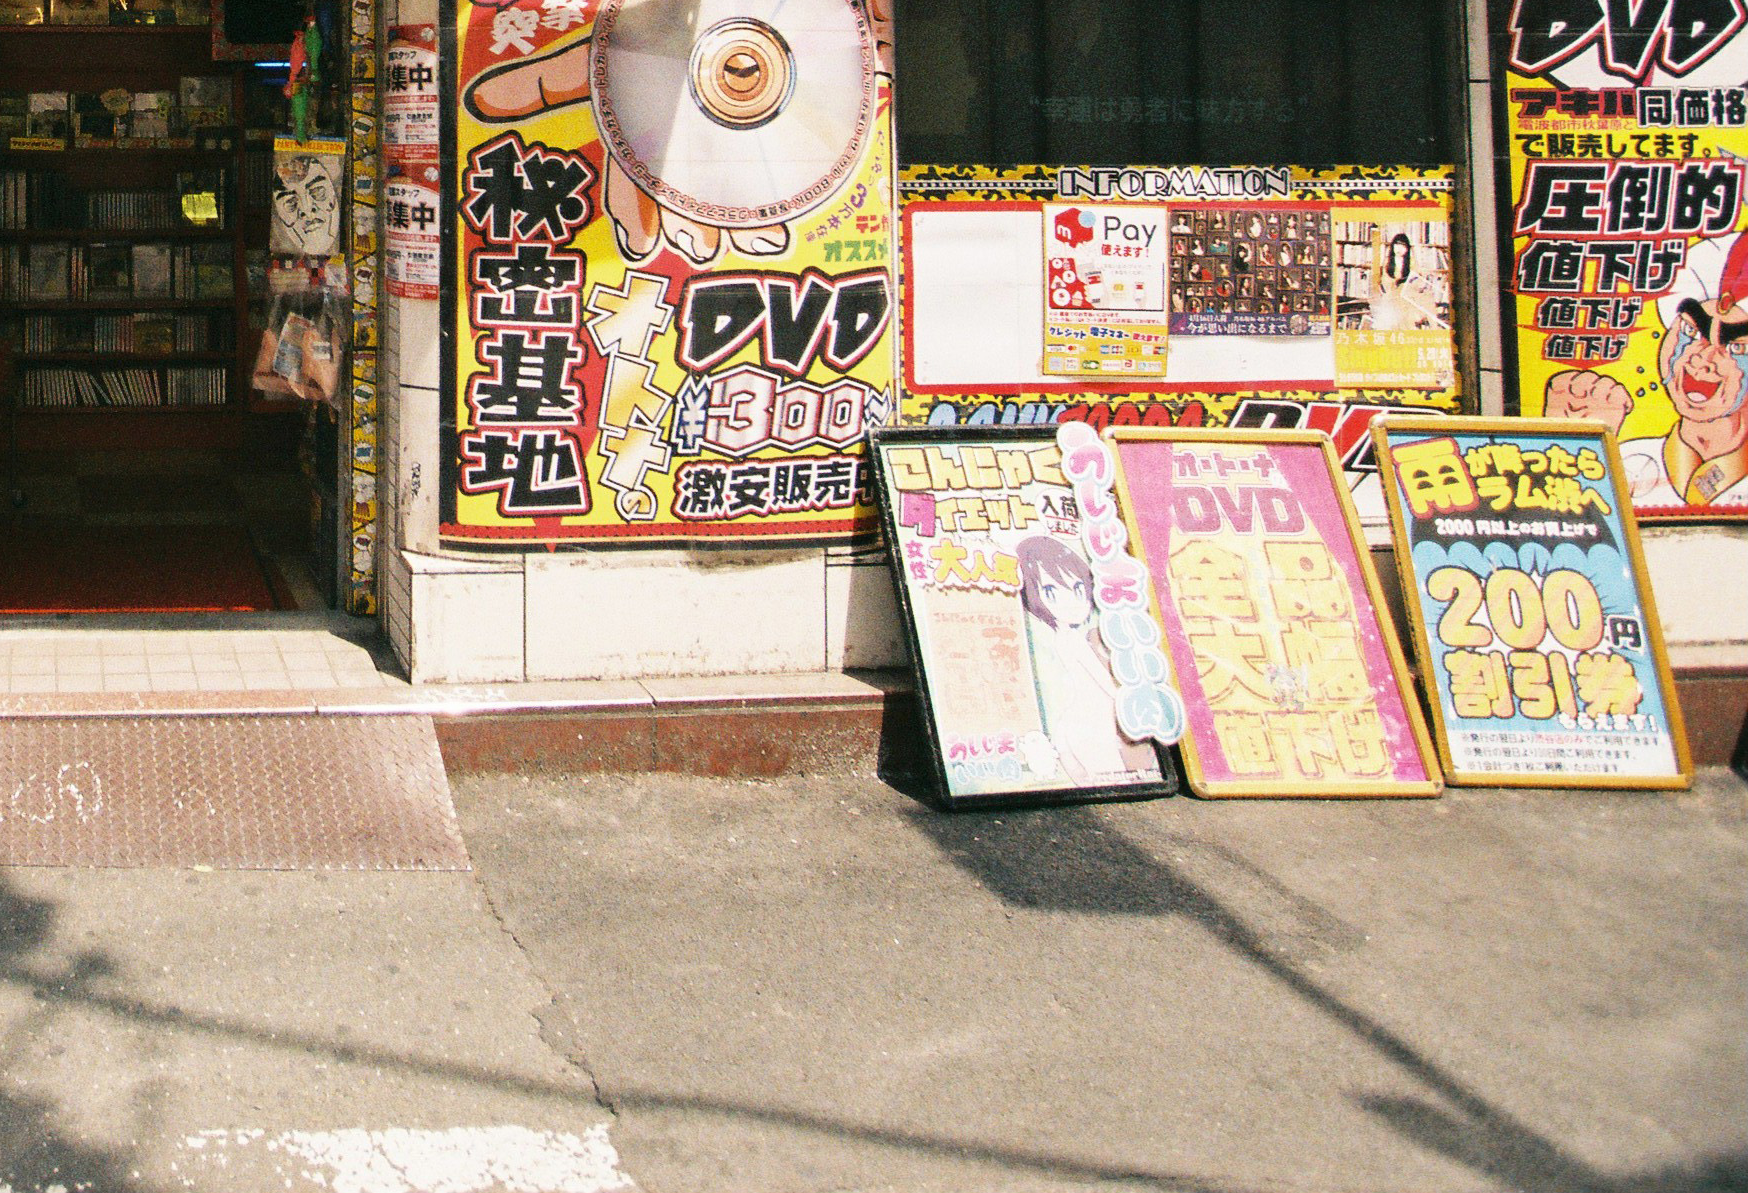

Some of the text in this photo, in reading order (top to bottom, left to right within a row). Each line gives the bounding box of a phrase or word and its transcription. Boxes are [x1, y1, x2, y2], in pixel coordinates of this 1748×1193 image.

[794, 176, 831, 207] BOOK
[1060, 169, 1291, 199] INFORMATION
[1516, 162, 1743, 236] 圧倒的
[1101, 244, 1150, 258] 使えます!
[1103, 216, 1157, 247] Pay
[1516, 239, 1687, 294] 値下げ
[462, 134, 598, 514] 秘密基地
[676, 269, 891, 372] DVD
[1049, 327, 1087, 339] クレジット
[1090, 326, 1130, 339] 電子マネー
[1535, 296, 1643, 330] 値下げ
[1543, 334, 1628, 360] 値下げ
[587, 269, 674, 522] オトナの
[1042, 495, 1080, 519] 入荷
[1171, 484, 1307, 537] DVD
[1426, 566, 1644, 653] 200 円
[1442, 651, 1644, 721] 割引券
